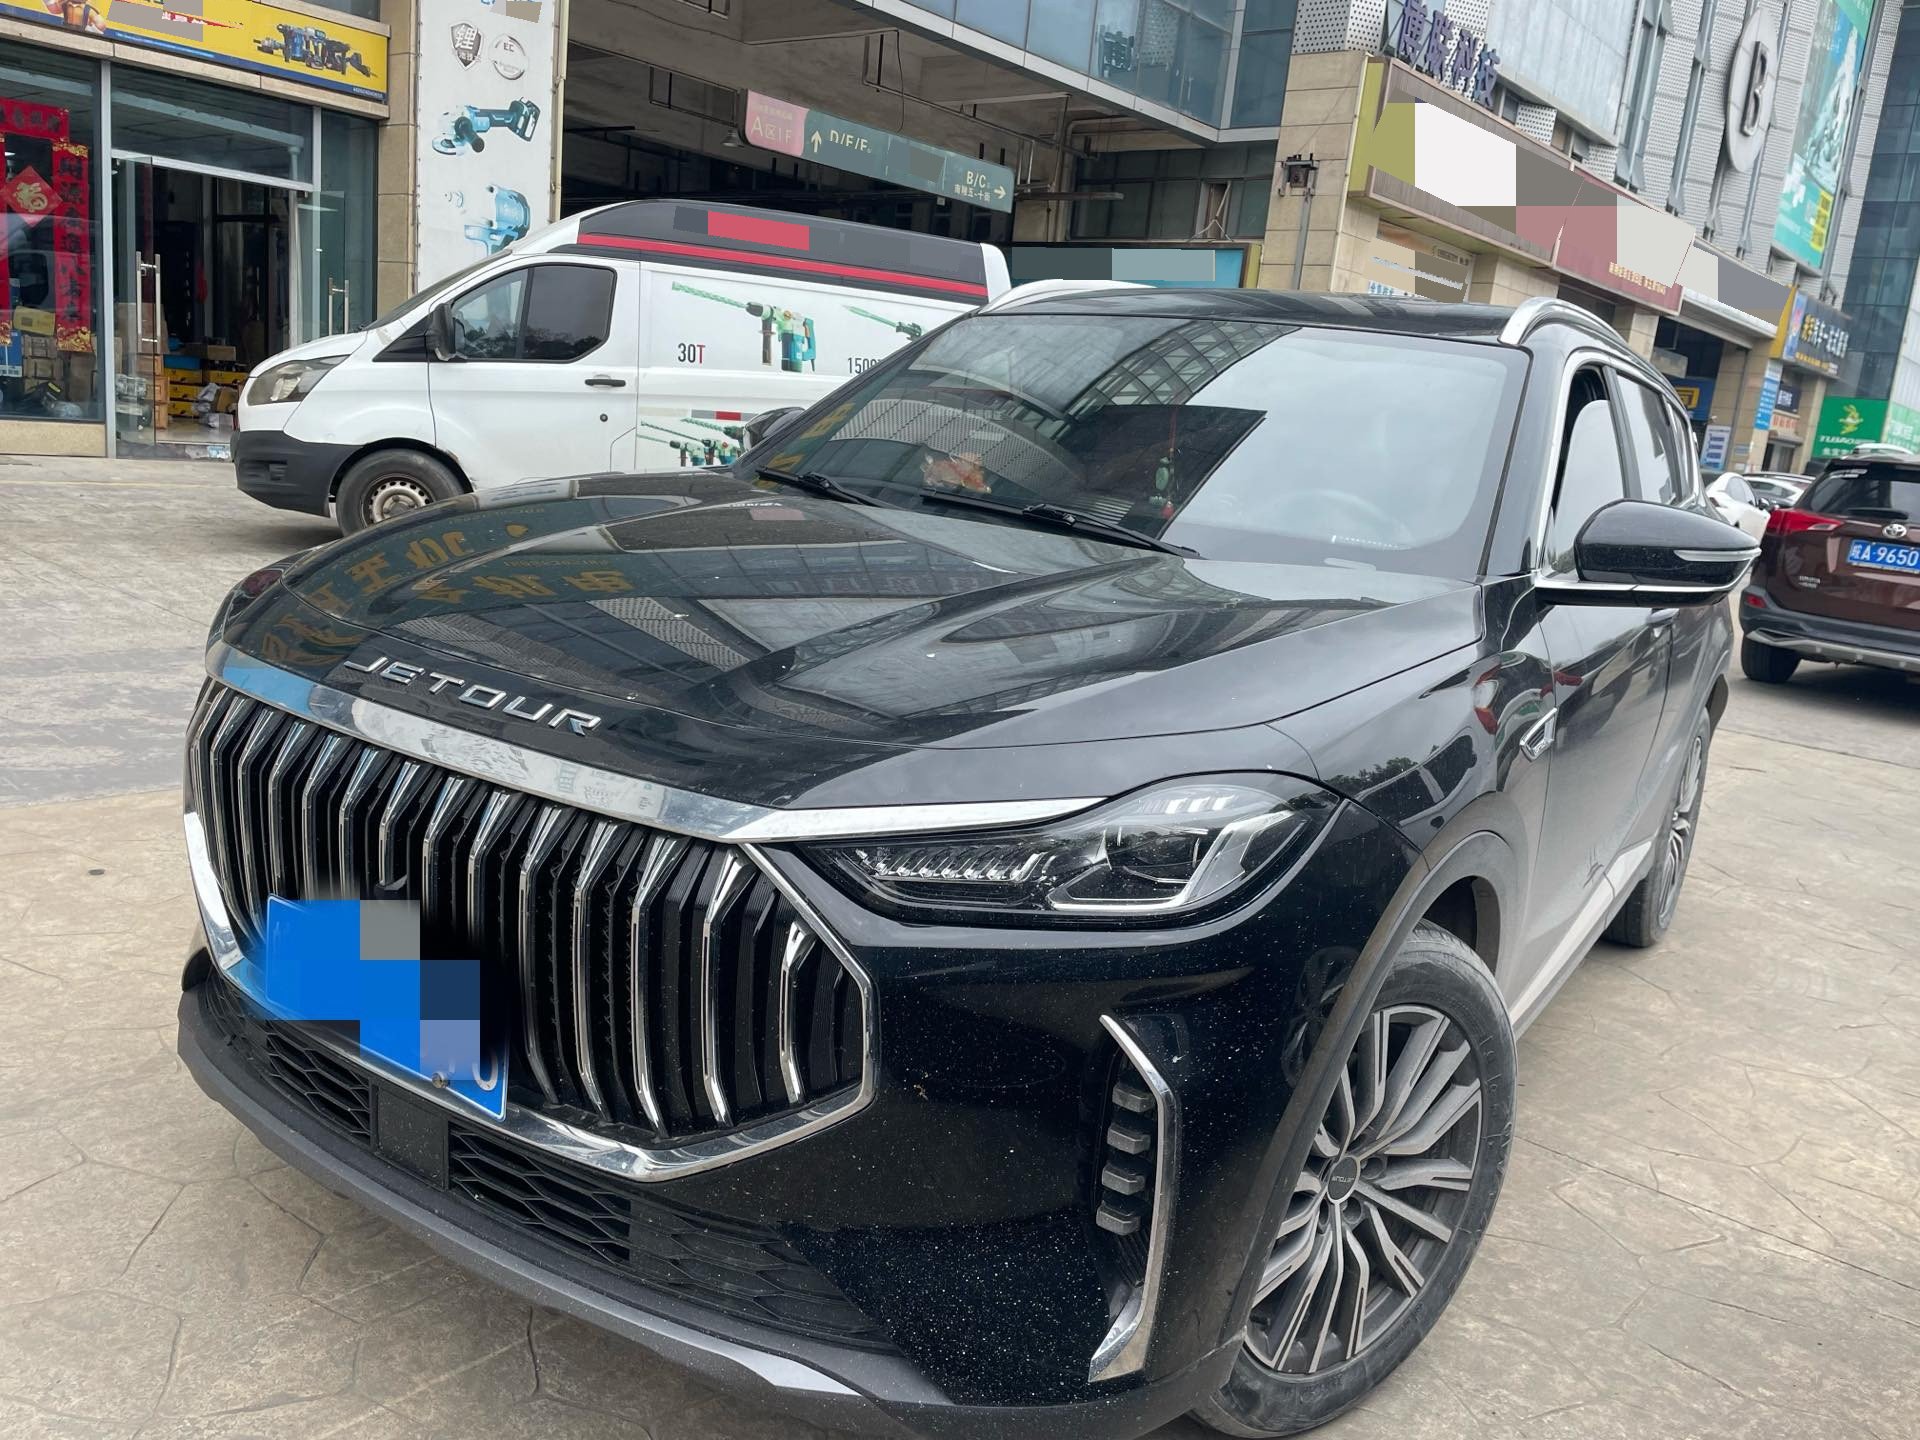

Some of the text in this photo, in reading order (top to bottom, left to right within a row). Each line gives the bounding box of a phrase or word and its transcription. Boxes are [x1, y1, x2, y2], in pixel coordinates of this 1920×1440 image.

[455, 24, 478, 50] 锂
[1739, 41, 1768, 137] B
[677, 343, 706, 364] 30T
[847, 357, 881, 374] 150
[343, 656, 602, 737] JETOUR
